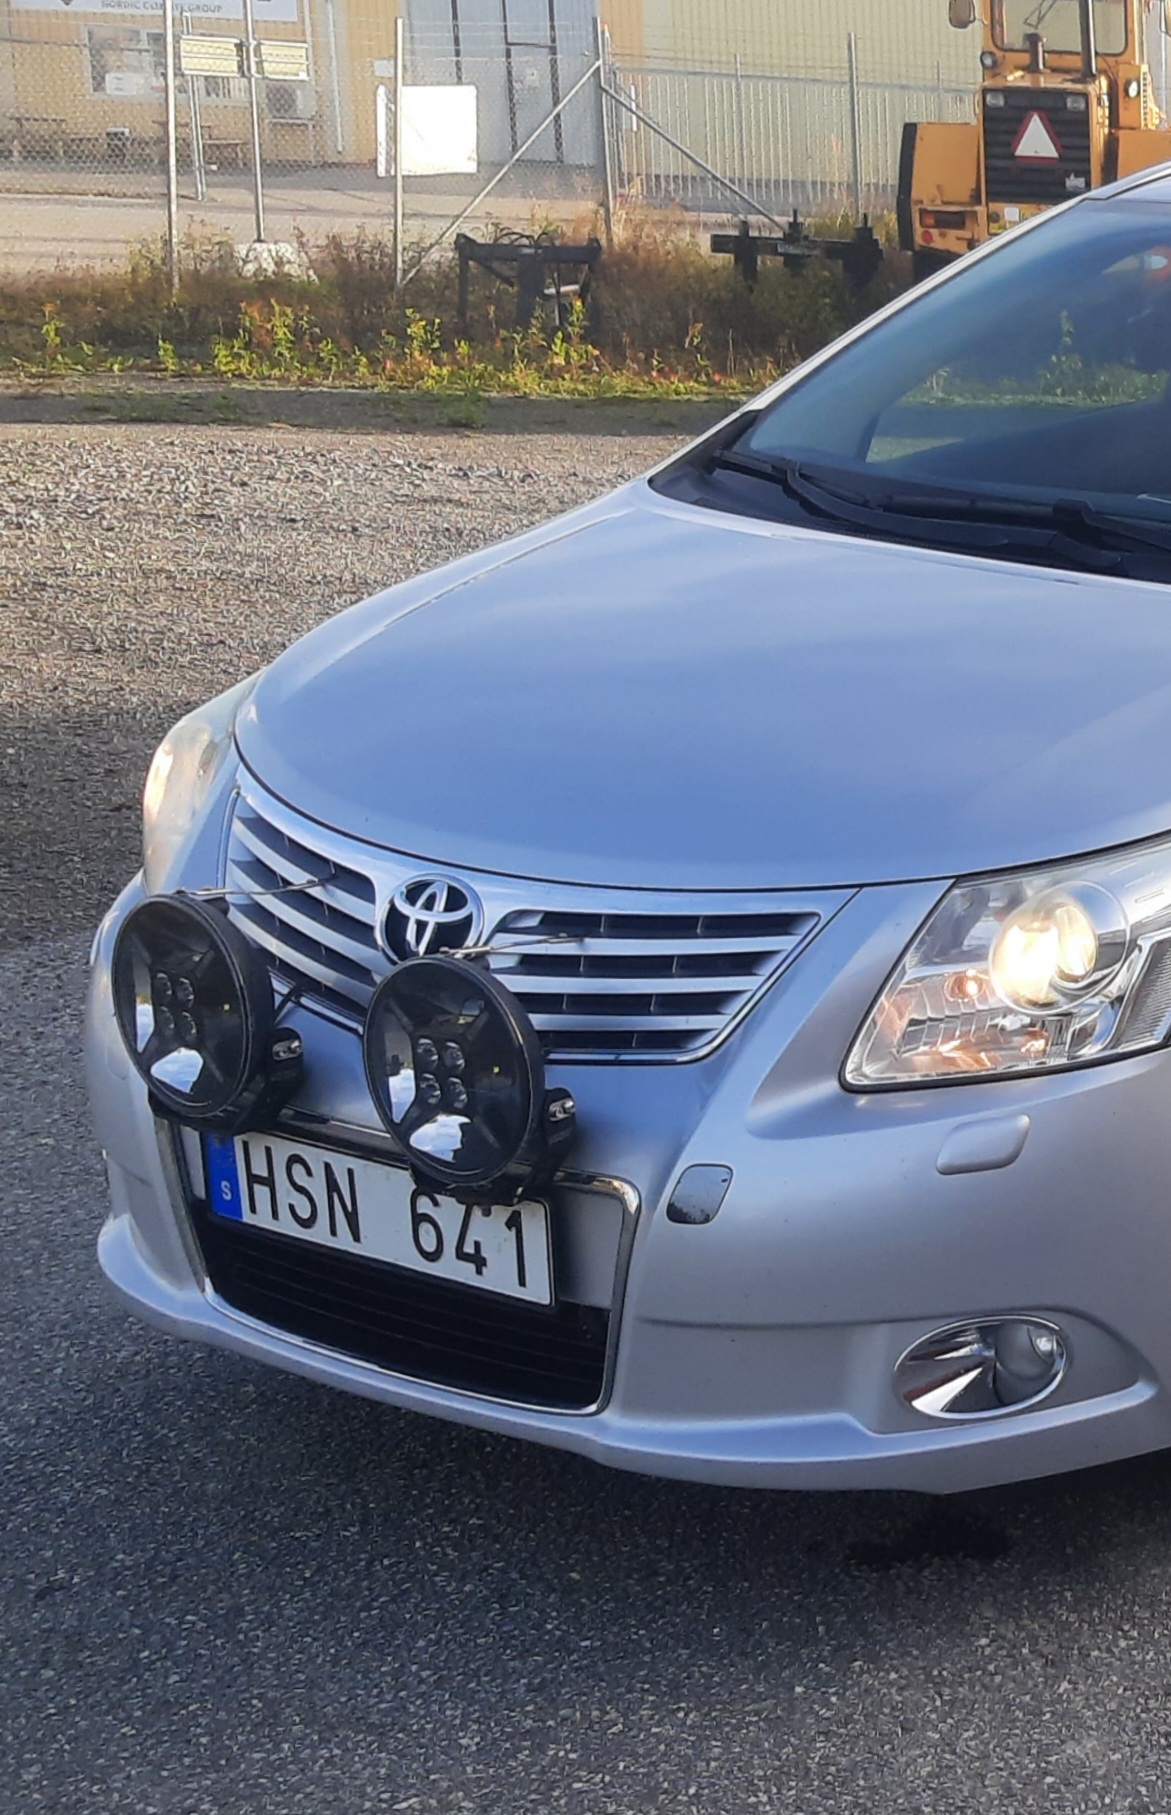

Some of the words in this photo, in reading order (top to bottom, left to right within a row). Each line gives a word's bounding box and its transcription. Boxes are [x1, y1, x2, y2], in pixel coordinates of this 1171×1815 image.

[188, 4, 222, 13] GROUP
[220, 1180, 232, 1201] S
[241, 1140, 361, 1243] HSN
[410, 1187, 527, 1289] 641
